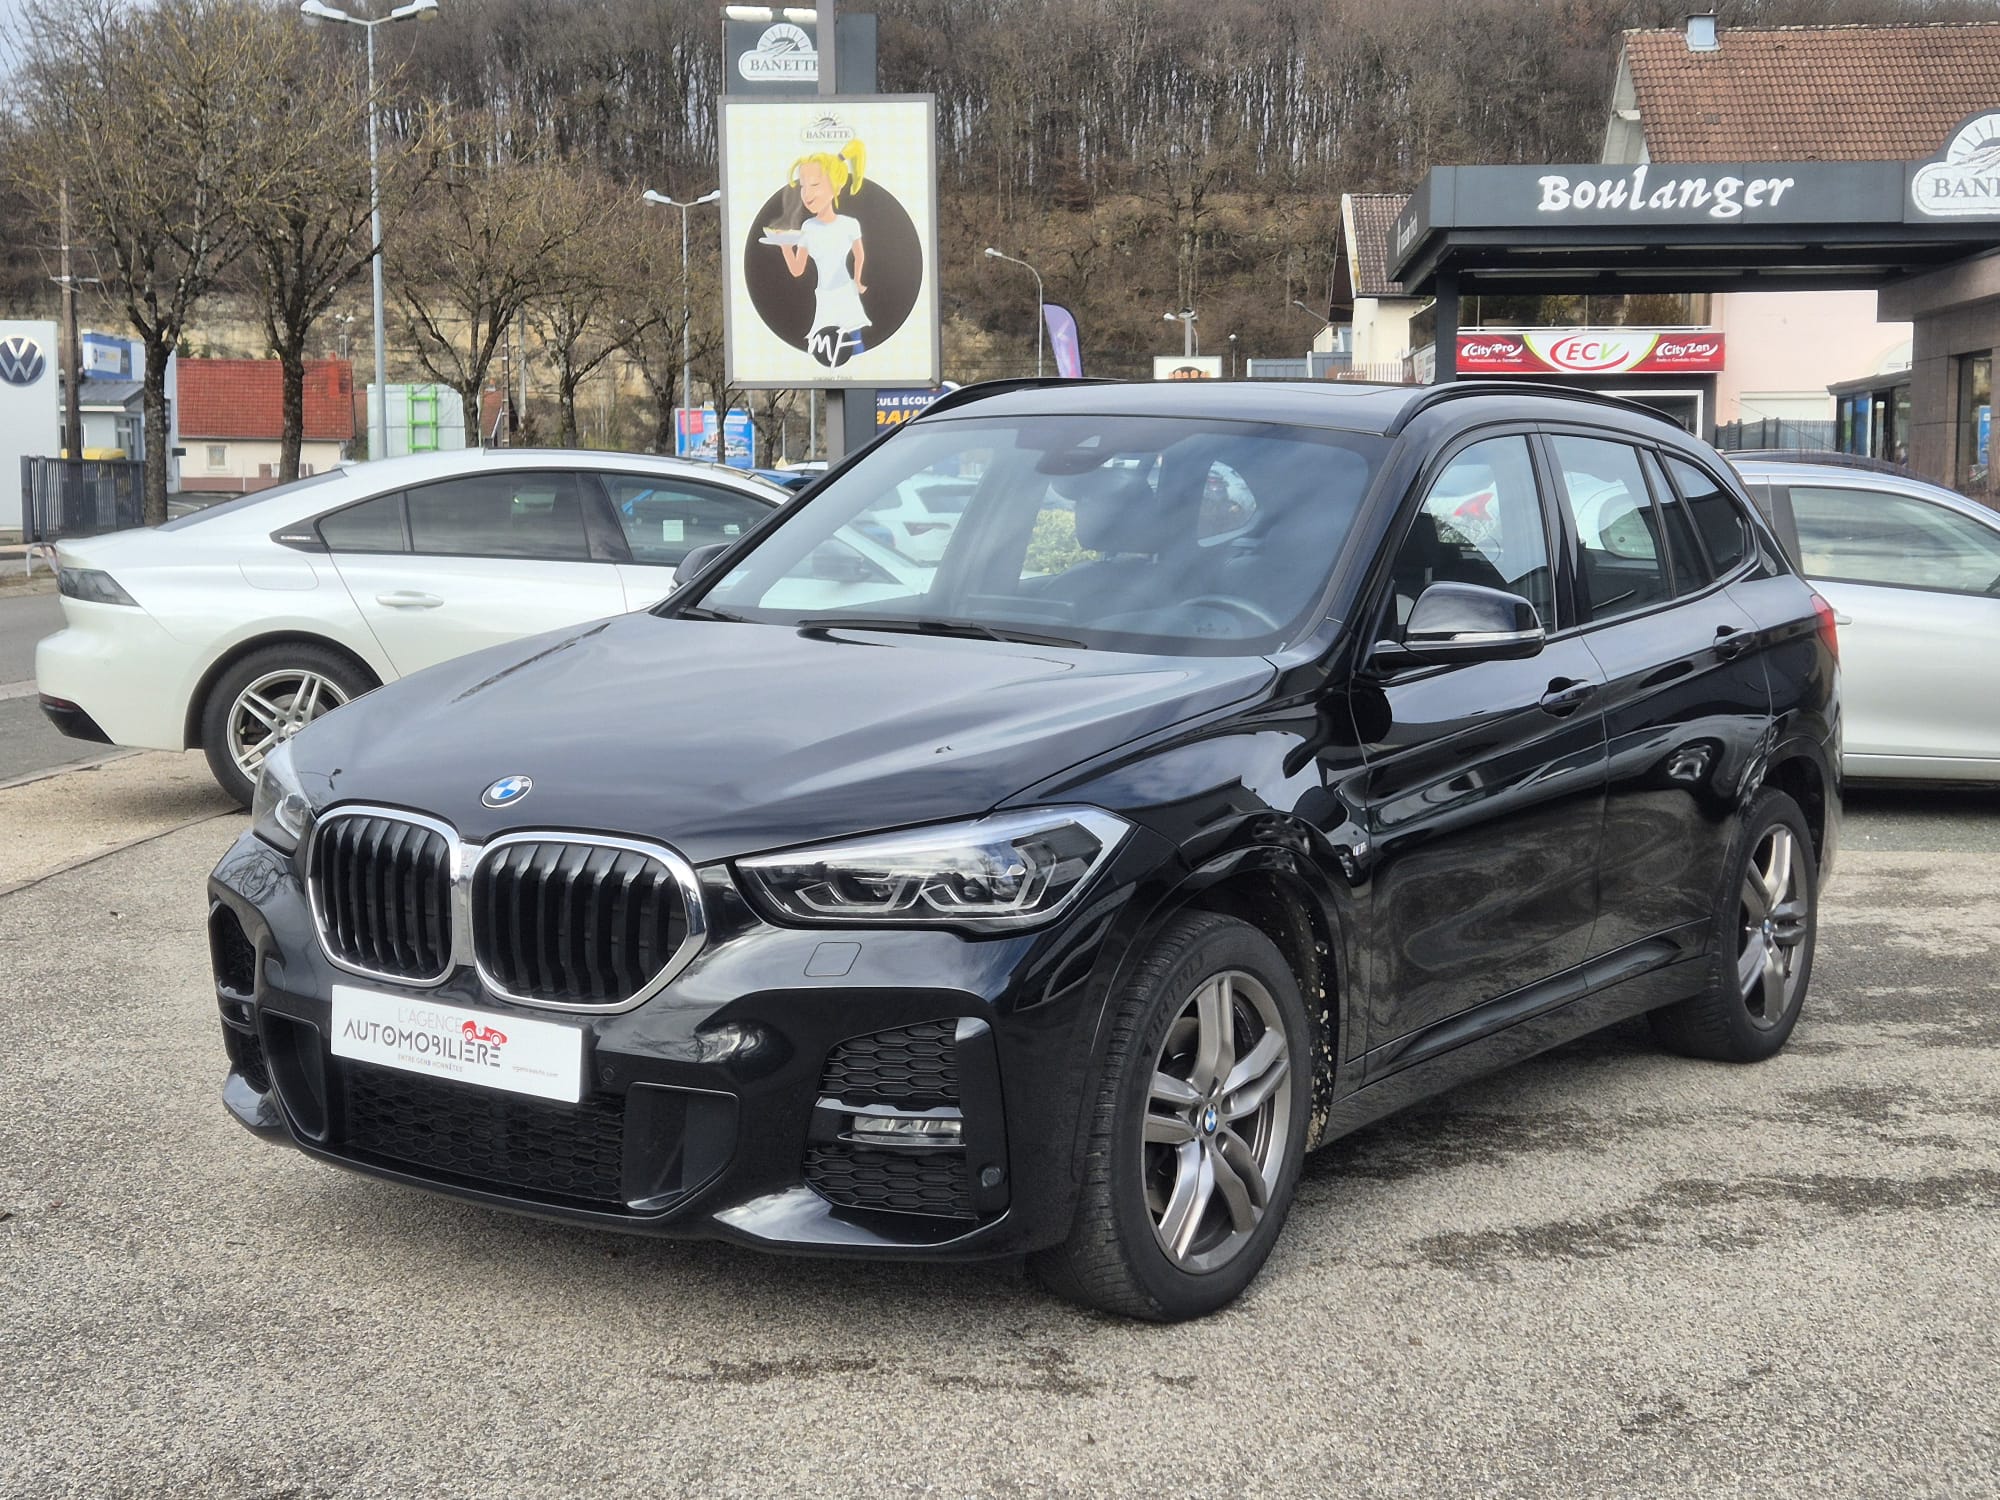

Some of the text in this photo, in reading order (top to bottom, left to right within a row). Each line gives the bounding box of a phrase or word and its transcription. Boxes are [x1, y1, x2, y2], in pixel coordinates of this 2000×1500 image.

[806, 129, 851, 139] BANETTE
[1538, 164, 1795, 218] Boulanger
[1933, 177, 2000, 198] BAN
[1565, 342, 1622, 362] ECV
[398, 1008, 464, 1034] L'AGENCE
